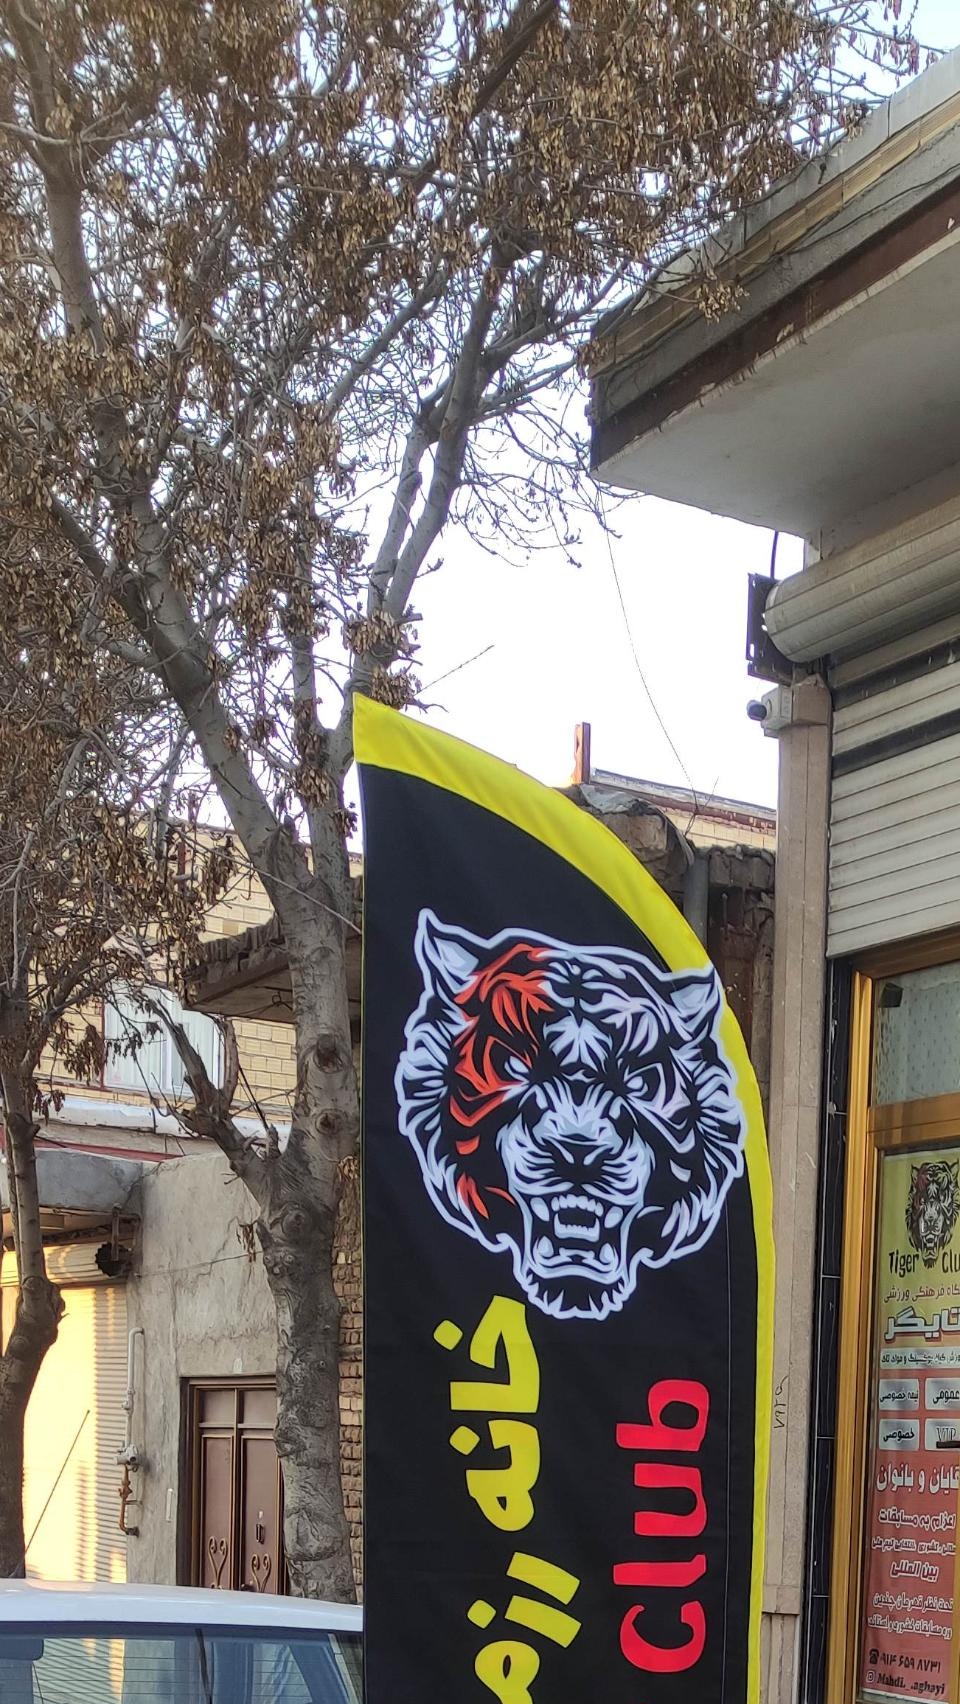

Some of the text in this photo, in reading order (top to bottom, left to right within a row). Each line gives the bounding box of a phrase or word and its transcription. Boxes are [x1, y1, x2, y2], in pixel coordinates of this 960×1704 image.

[888, 1249, 919, 1278] Tiger
[880, 1387, 906, 1403] خصوصی
[932, 1389, 960, 1404] عمومی
[433, 1295, 542, 1532] خانه
[883, 1427, 915, 1442] خصوصی
[936, 1426, 957, 1441] VIP
[877, 1463, 960, 1493] قایان و بانوان
[613, 1378, 710, 1674] Club
[879, 1506, 918, 1528] مسابقات
[931, 1511, 957, 1532] اعزام
[890, 1560, 939, 1583] بین المللی
